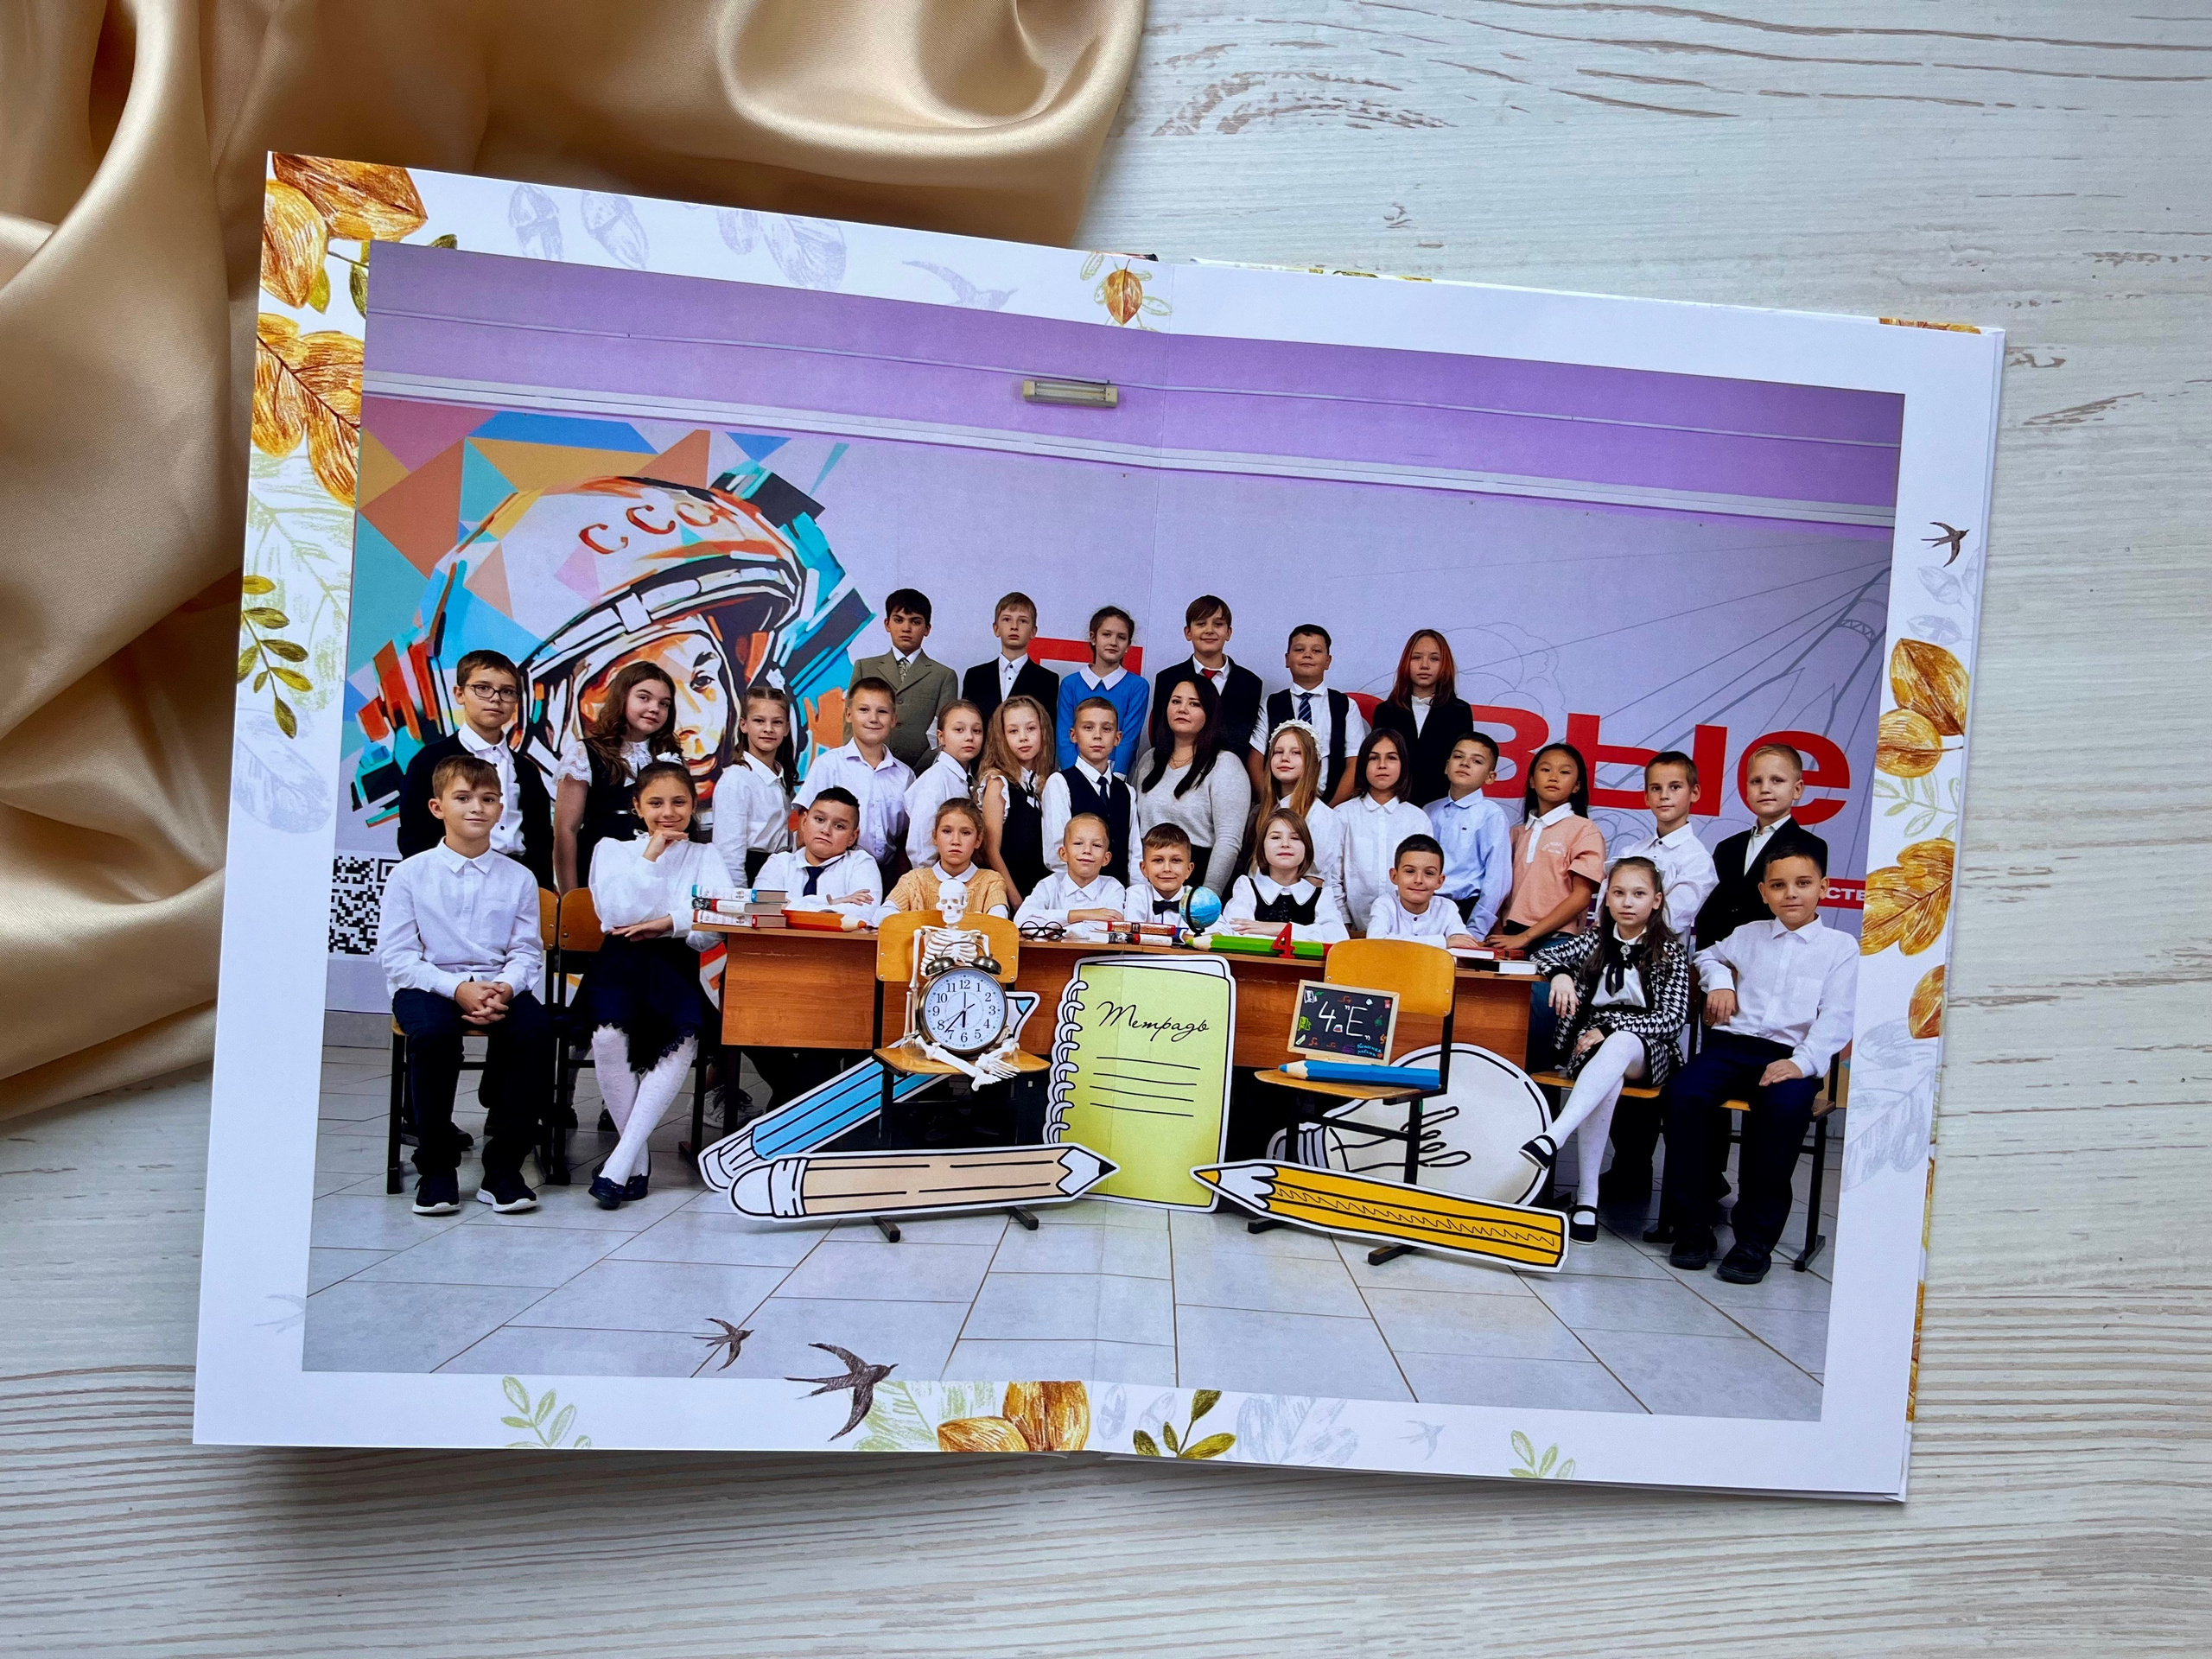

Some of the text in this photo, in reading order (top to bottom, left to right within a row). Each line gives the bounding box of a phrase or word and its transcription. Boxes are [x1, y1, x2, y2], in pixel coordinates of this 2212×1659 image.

[1272, 922, 1296, 959] 4
[946, 982, 957, 992] 11
[959, 979, 970, 989] 12
[976, 982, 981, 992] 1
[937, 993, 948, 1003] 10
[985, 992, 992, 1001] 2
[932, 1006, 940, 1016] 9
[988, 1005, 996, 1015] 3
[937, 1020, 944, 1030] 8
[983, 1019, 990, 1028] 4
[1096, 1001, 1210, 1042] Тетрадь
[947, 1029, 955, 1039] 7
[960, 1033, 968, 1043] 6
[974, 1029, 982, 1039] 5
